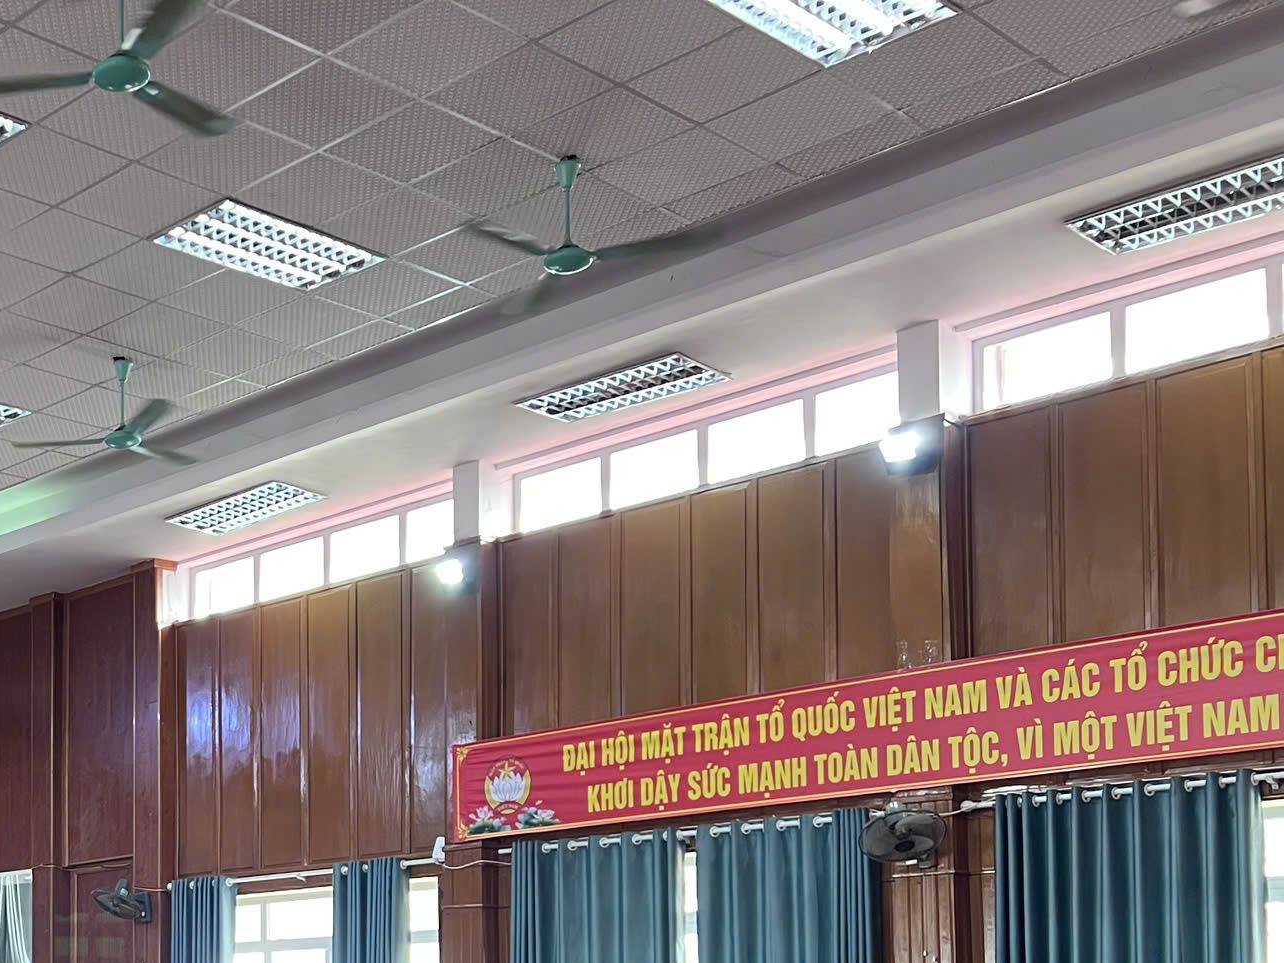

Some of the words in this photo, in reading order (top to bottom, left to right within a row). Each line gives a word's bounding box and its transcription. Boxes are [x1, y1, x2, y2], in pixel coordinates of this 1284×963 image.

[563, 741, 595, 776] ĐẠI
[601, 730, 635, 770] HỘI
[641, 723, 686, 763] MẶT
[692, 713, 750, 755] TRẬN
[756, 699, 785, 743] TỔ
[791, 691, 856, 741] QUỐC
[862, 686, 916, 733] VIỆT
[924, 679, 988, 720] NAM
[996, 666, 1033, 709] VÀ
[1041, 658, 1101, 703] CÁC
[1109, 640, 1148, 693] TỔ
[1157, 636, 1244, 687] CHỨC
[587, 777, 635, 813] KHƠI
[641, 769, 681, 811] DẬY
[688, 763, 731, 800] SỨC
[738, 756, 807, 798] MẠNH
[814, 743, 878, 786] TOÀN
[886, 735, 940, 776] DÂN
[947, 727, 1008, 774] TỘC,
[1016, 718, 1044, 761] VÌ
[1053, 711, 1117, 760] MỘT
[1126, 701, 1192, 752] VIỆT
[1203, 693, 1281, 739] NAM
